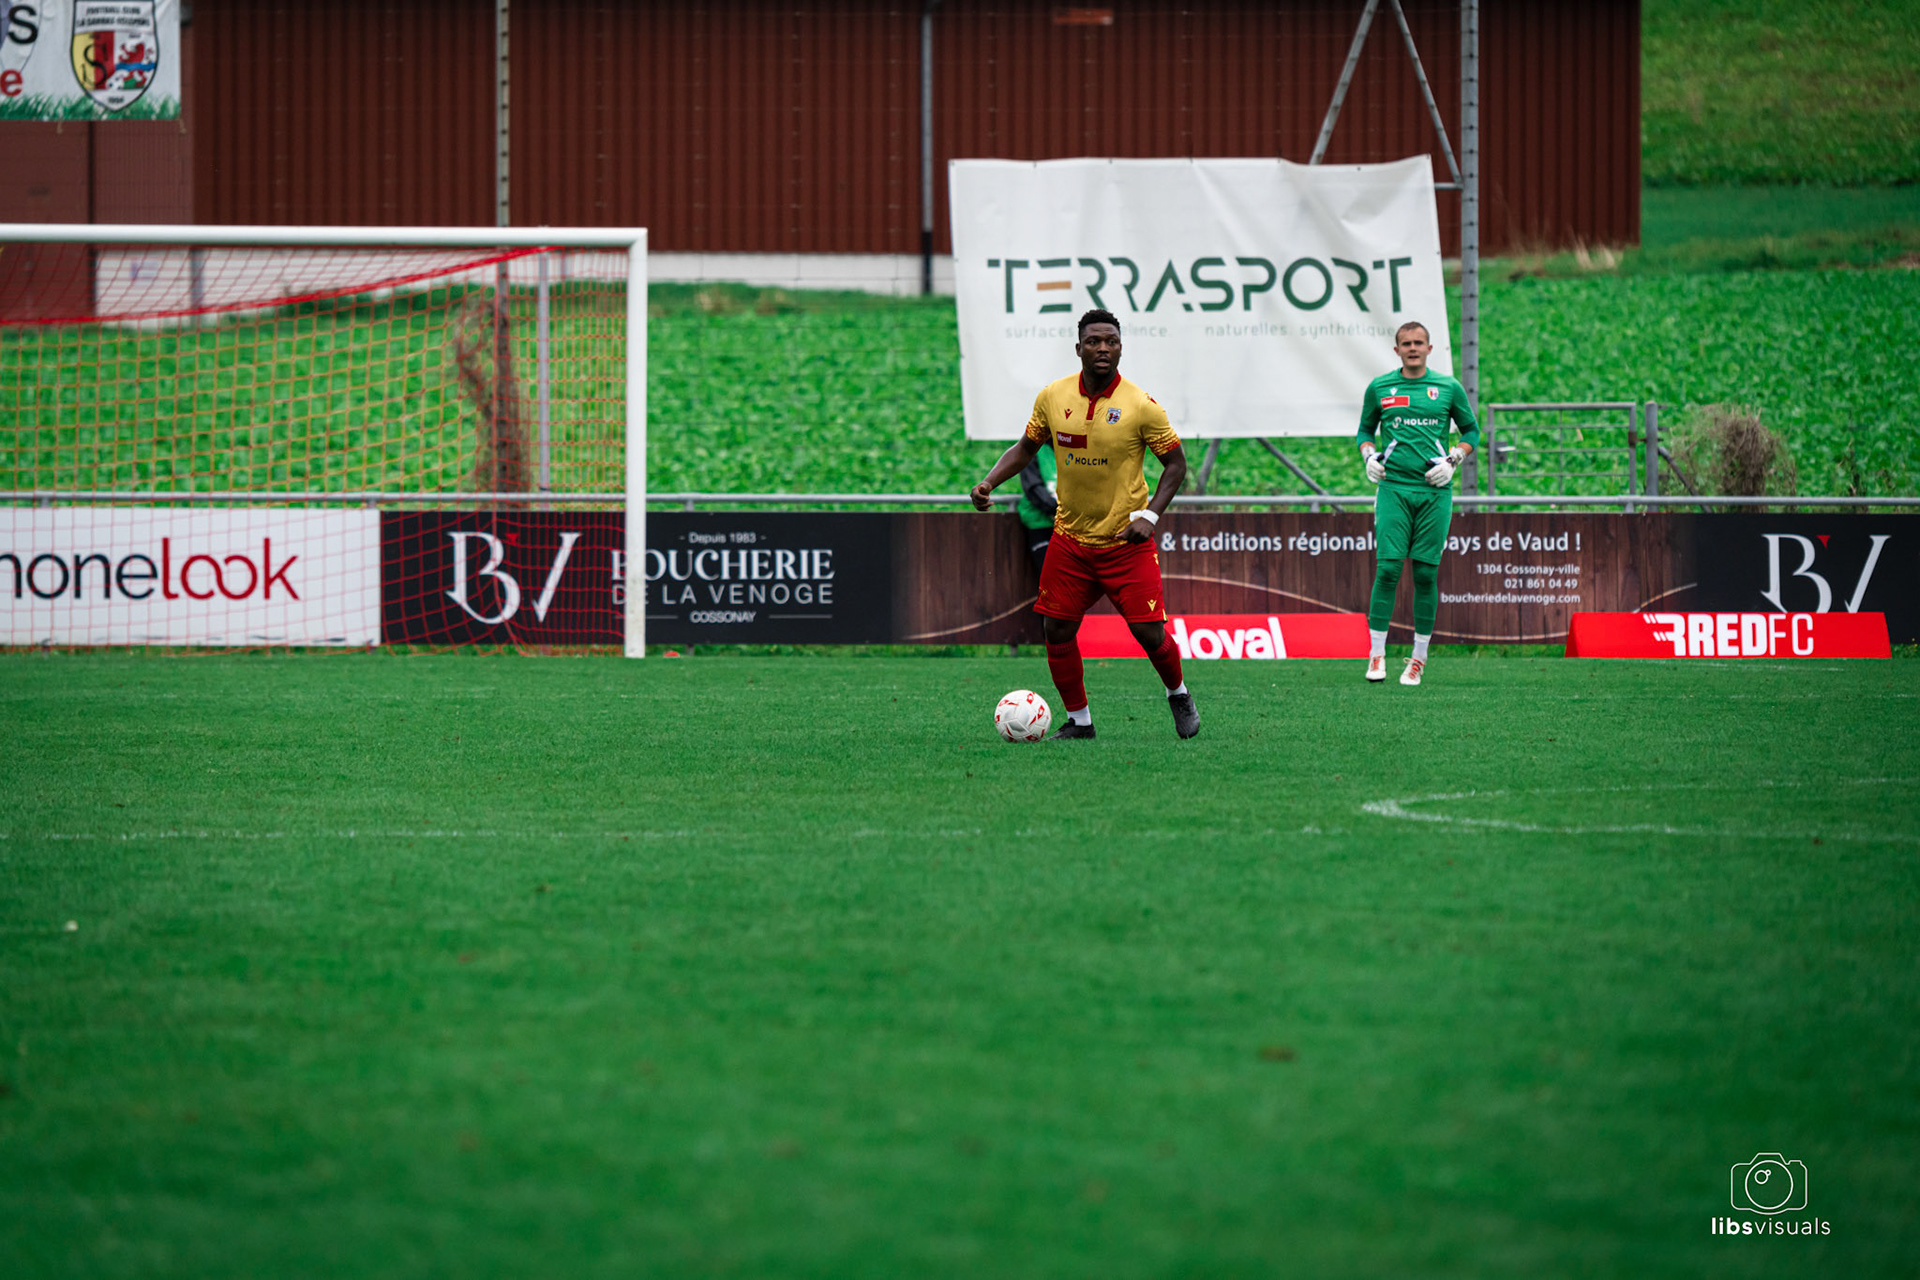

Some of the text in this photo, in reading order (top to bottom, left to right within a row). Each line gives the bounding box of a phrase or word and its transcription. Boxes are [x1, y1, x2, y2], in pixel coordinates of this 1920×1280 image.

[987, 256, 1413, 313] TERRASPORT
[1075, 457, 1108, 466] HOLCIM
[688, 531, 756, 545] Depuis 1983
[1160, 532, 1176, 551] &
[1181, 531, 1282, 552] traditions
[1288, 531, 1377, 556] régional
[1486, 531, 1512, 551] de
[1518, 531, 1568, 551] Vaud
[1476, 563, 1581, 577] 1304 Cossonay-ville
[1504, 578, 1578, 589] 021 861 04 49
[612, 583, 833, 605] D LA VENOGE
[1440, 592, 1581, 606] boucheriedelavenoge.com
[689, 610, 756, 623] COSSONAY
